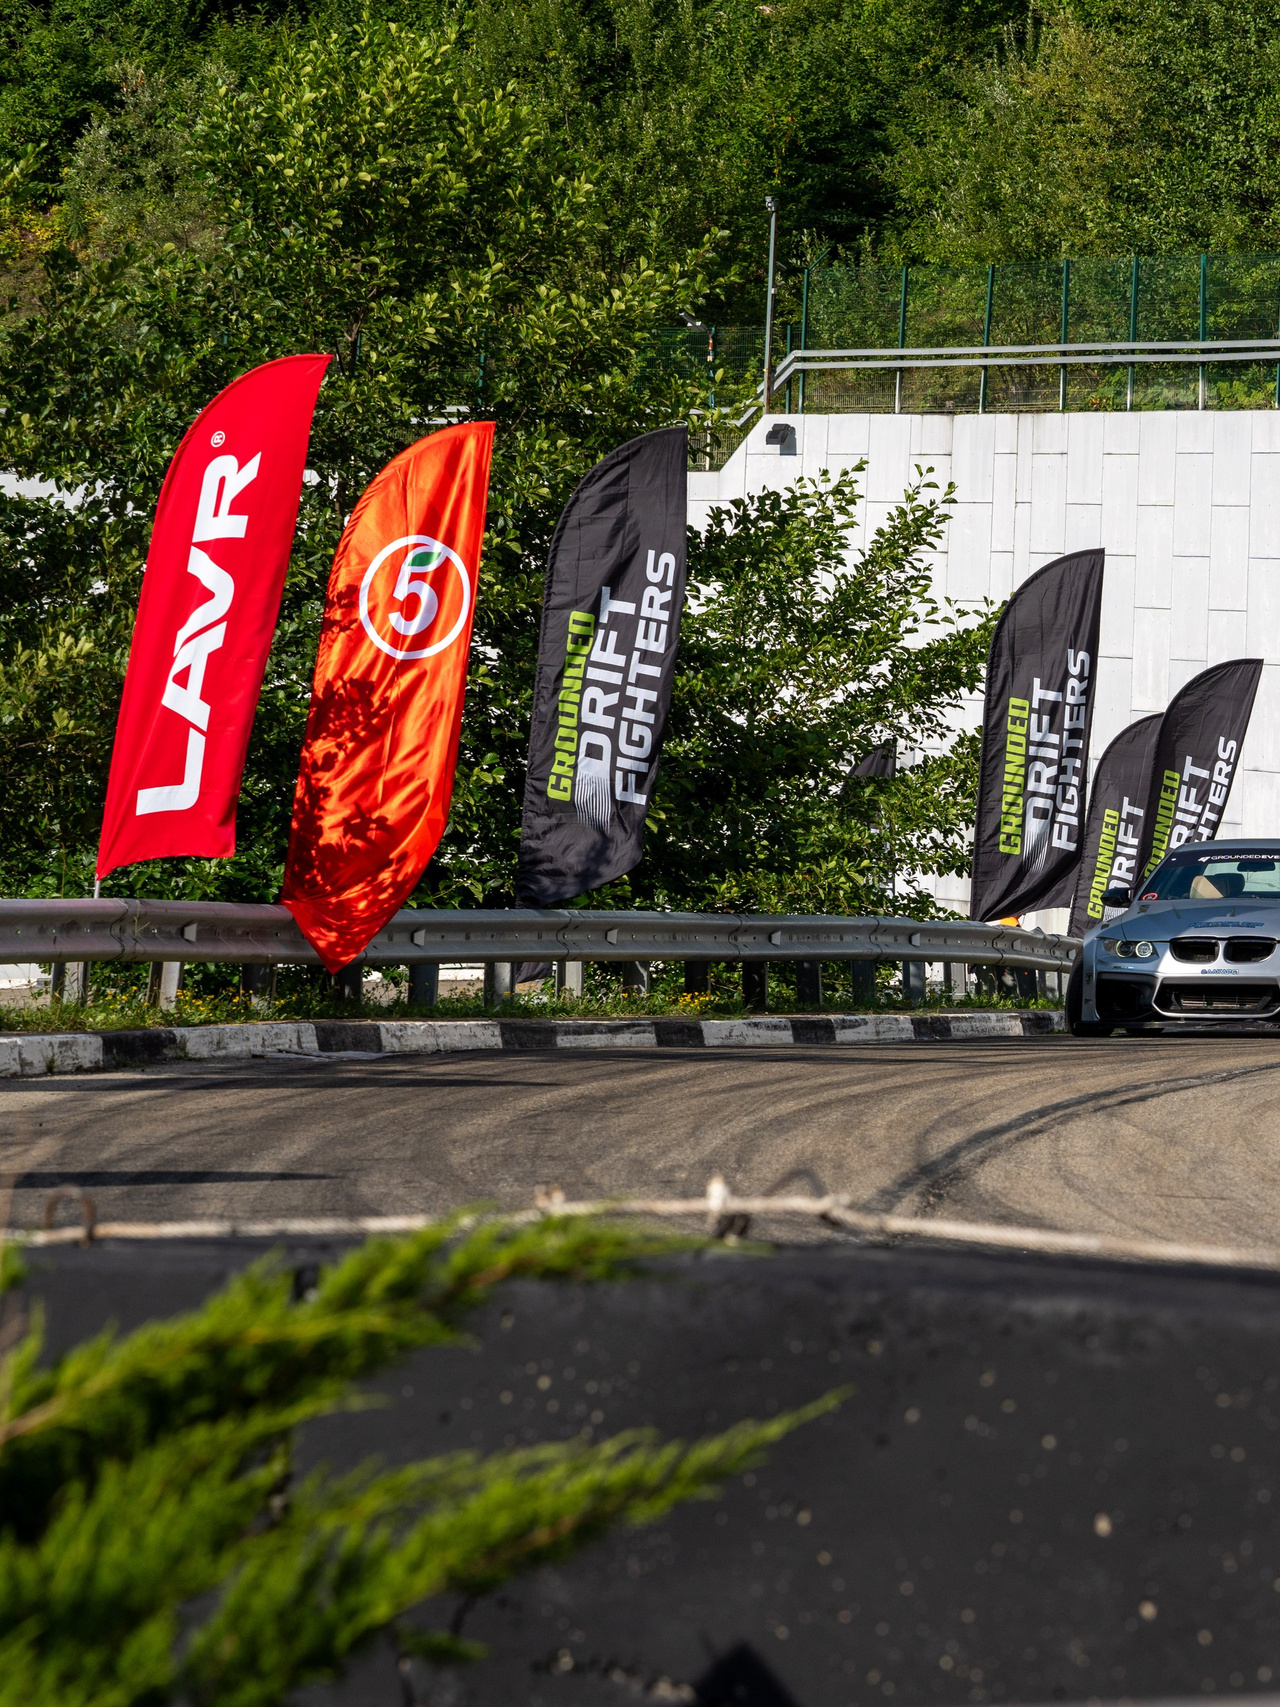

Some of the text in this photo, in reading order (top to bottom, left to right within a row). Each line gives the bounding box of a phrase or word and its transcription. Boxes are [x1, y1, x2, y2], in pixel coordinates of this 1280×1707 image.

[547, 611, 595, 801] GROUNDED
[575, 586, 637, 815] DRIFT
[615, 549, 676, 806] FIGHTERS
[1023, 677, 1063, 850] DRIFT
[1051, 648, 1090, 851] FIGHTERS
[999, 697, 1029, 855] GROUNDED
[1169, 755, 1210, 849] RIFT
[1195, 736, 1237, 842] HTERS
[1087, 808, 1119, 919] GROUNDED
